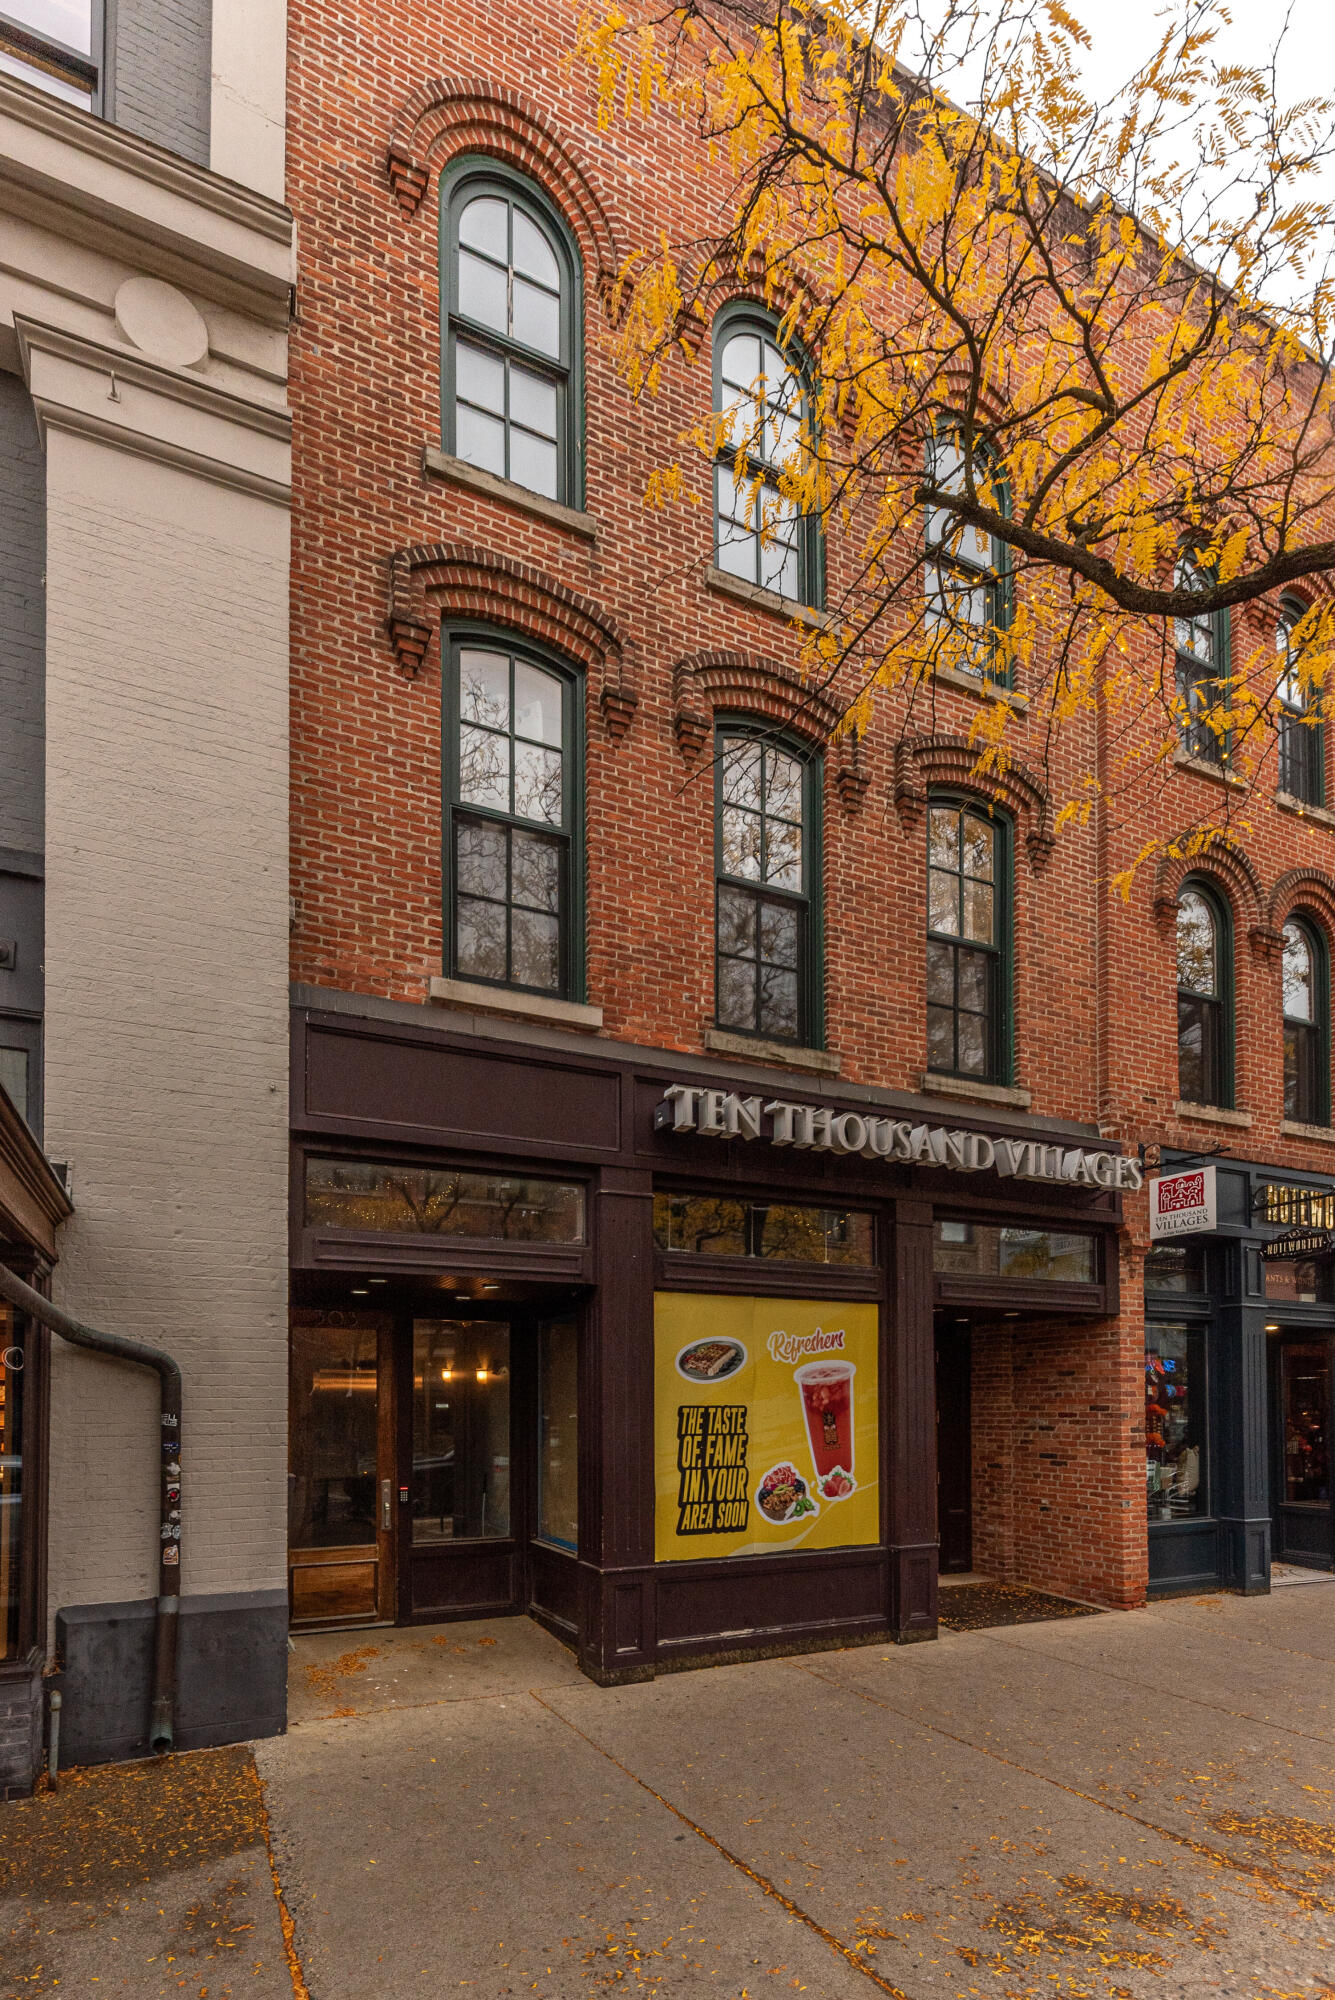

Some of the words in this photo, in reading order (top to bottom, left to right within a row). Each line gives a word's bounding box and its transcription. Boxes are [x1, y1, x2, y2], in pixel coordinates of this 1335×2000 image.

[663, 1083, 762, 1141] TEN
[764, 1099, 995, 1174] THOUSAND
[993, 1137, 1143, 1191] VILLAGES
[1155, 1214, 1208, 1231] VILLAGES
[1169, 1208, 1208, 1220] THOUSAND
[1267, 1235, 1323, 1256] NOTEWORTHY
[767, 1327, 845, 1364] Refreshers
[681, 1407, 705, 1434] THE
[708, 1407, 745, 1434] TASTE
[705, 1434, 746, 1467] FAME
[707, 1467, 747, 1503] YOUR
[681, 1503, 714, 1530] AREA
[716, 1501, 748, 1528] SOON
